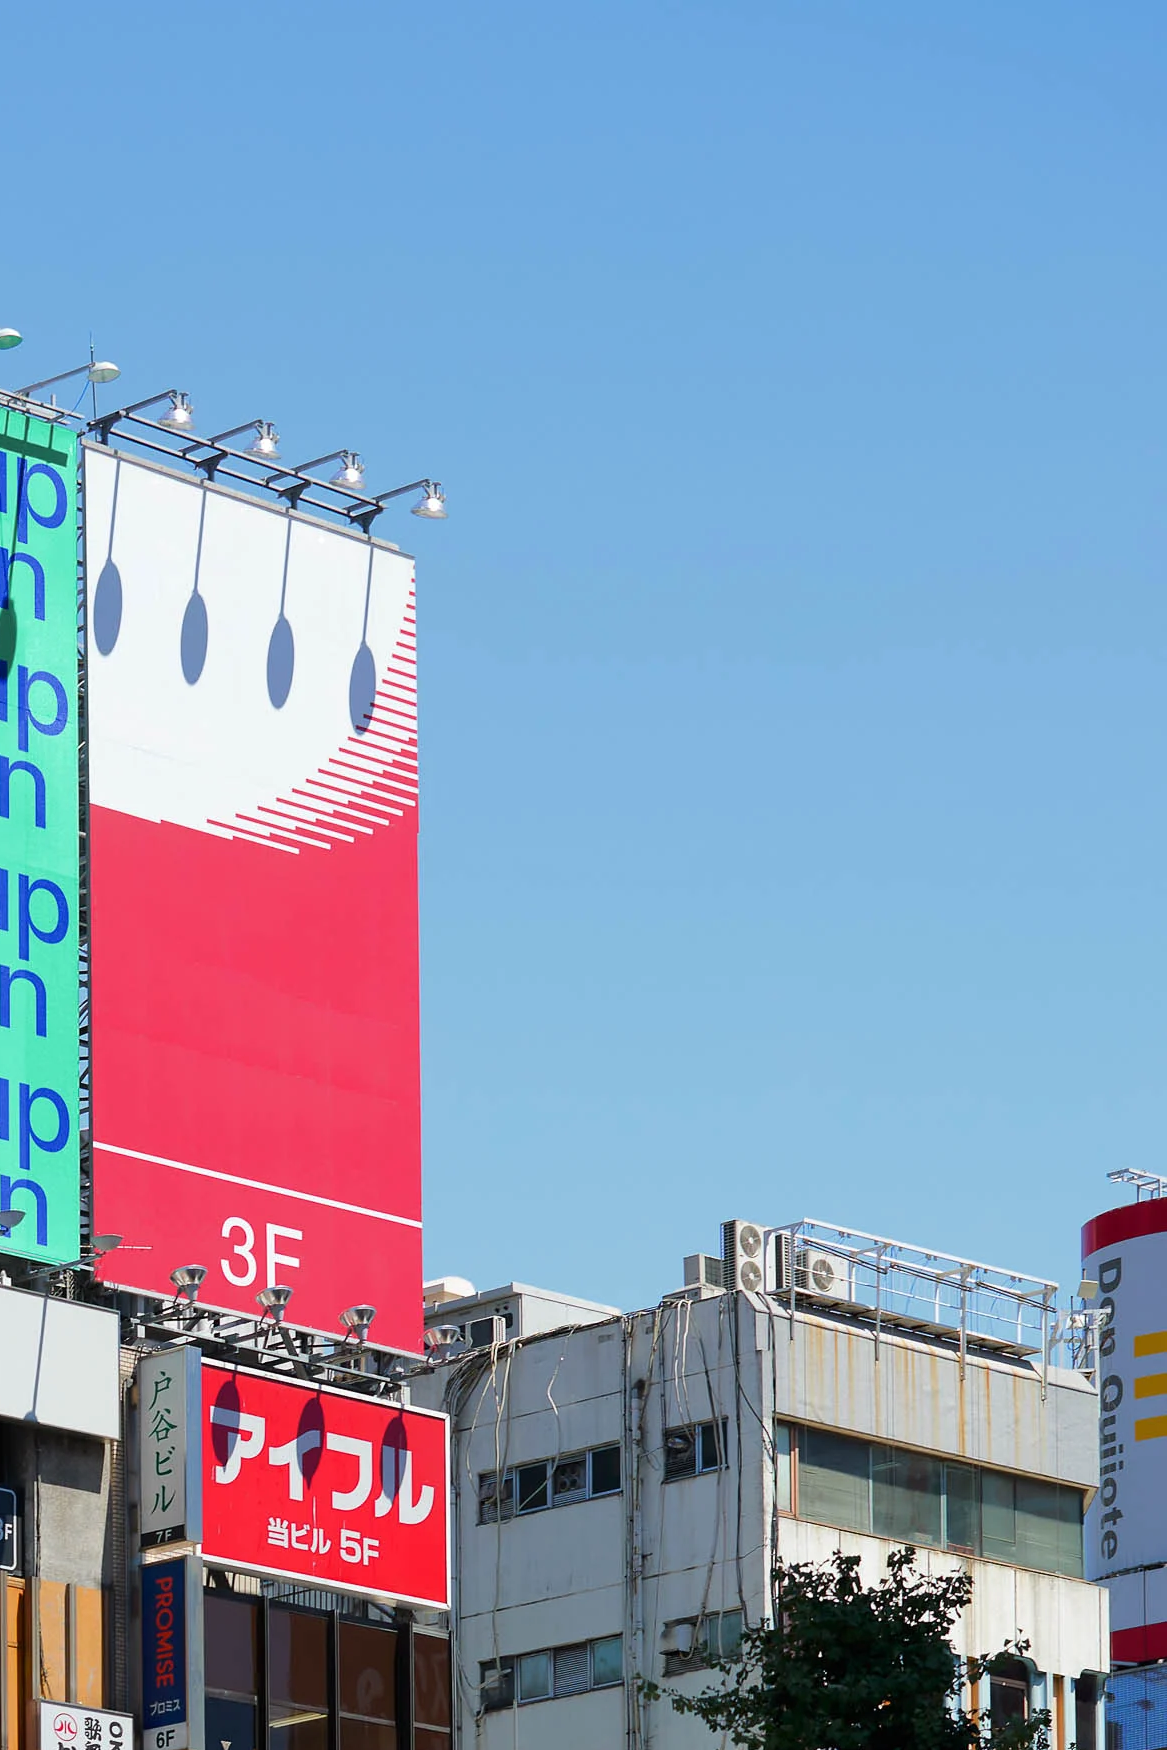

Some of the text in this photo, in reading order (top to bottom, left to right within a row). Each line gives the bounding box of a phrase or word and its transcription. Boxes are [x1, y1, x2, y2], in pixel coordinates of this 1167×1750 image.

[220, 1217, 303, 1288] 3F
[148, 1371, 178, 1515] 戸谷ビル
[1098, 1256, 1125, 1562] Don Quijote
[210, 1405, 435, 1526] アイフル
[155, 1529, 173, 1544] 7F
[266, 1517, 381, 1566] 当ビル 5F
[155, 1576, 175, 1688] PROMISE
[149, 1698, 181, 1718] プロミス
[155, 1729, 176, 1749] 6F
